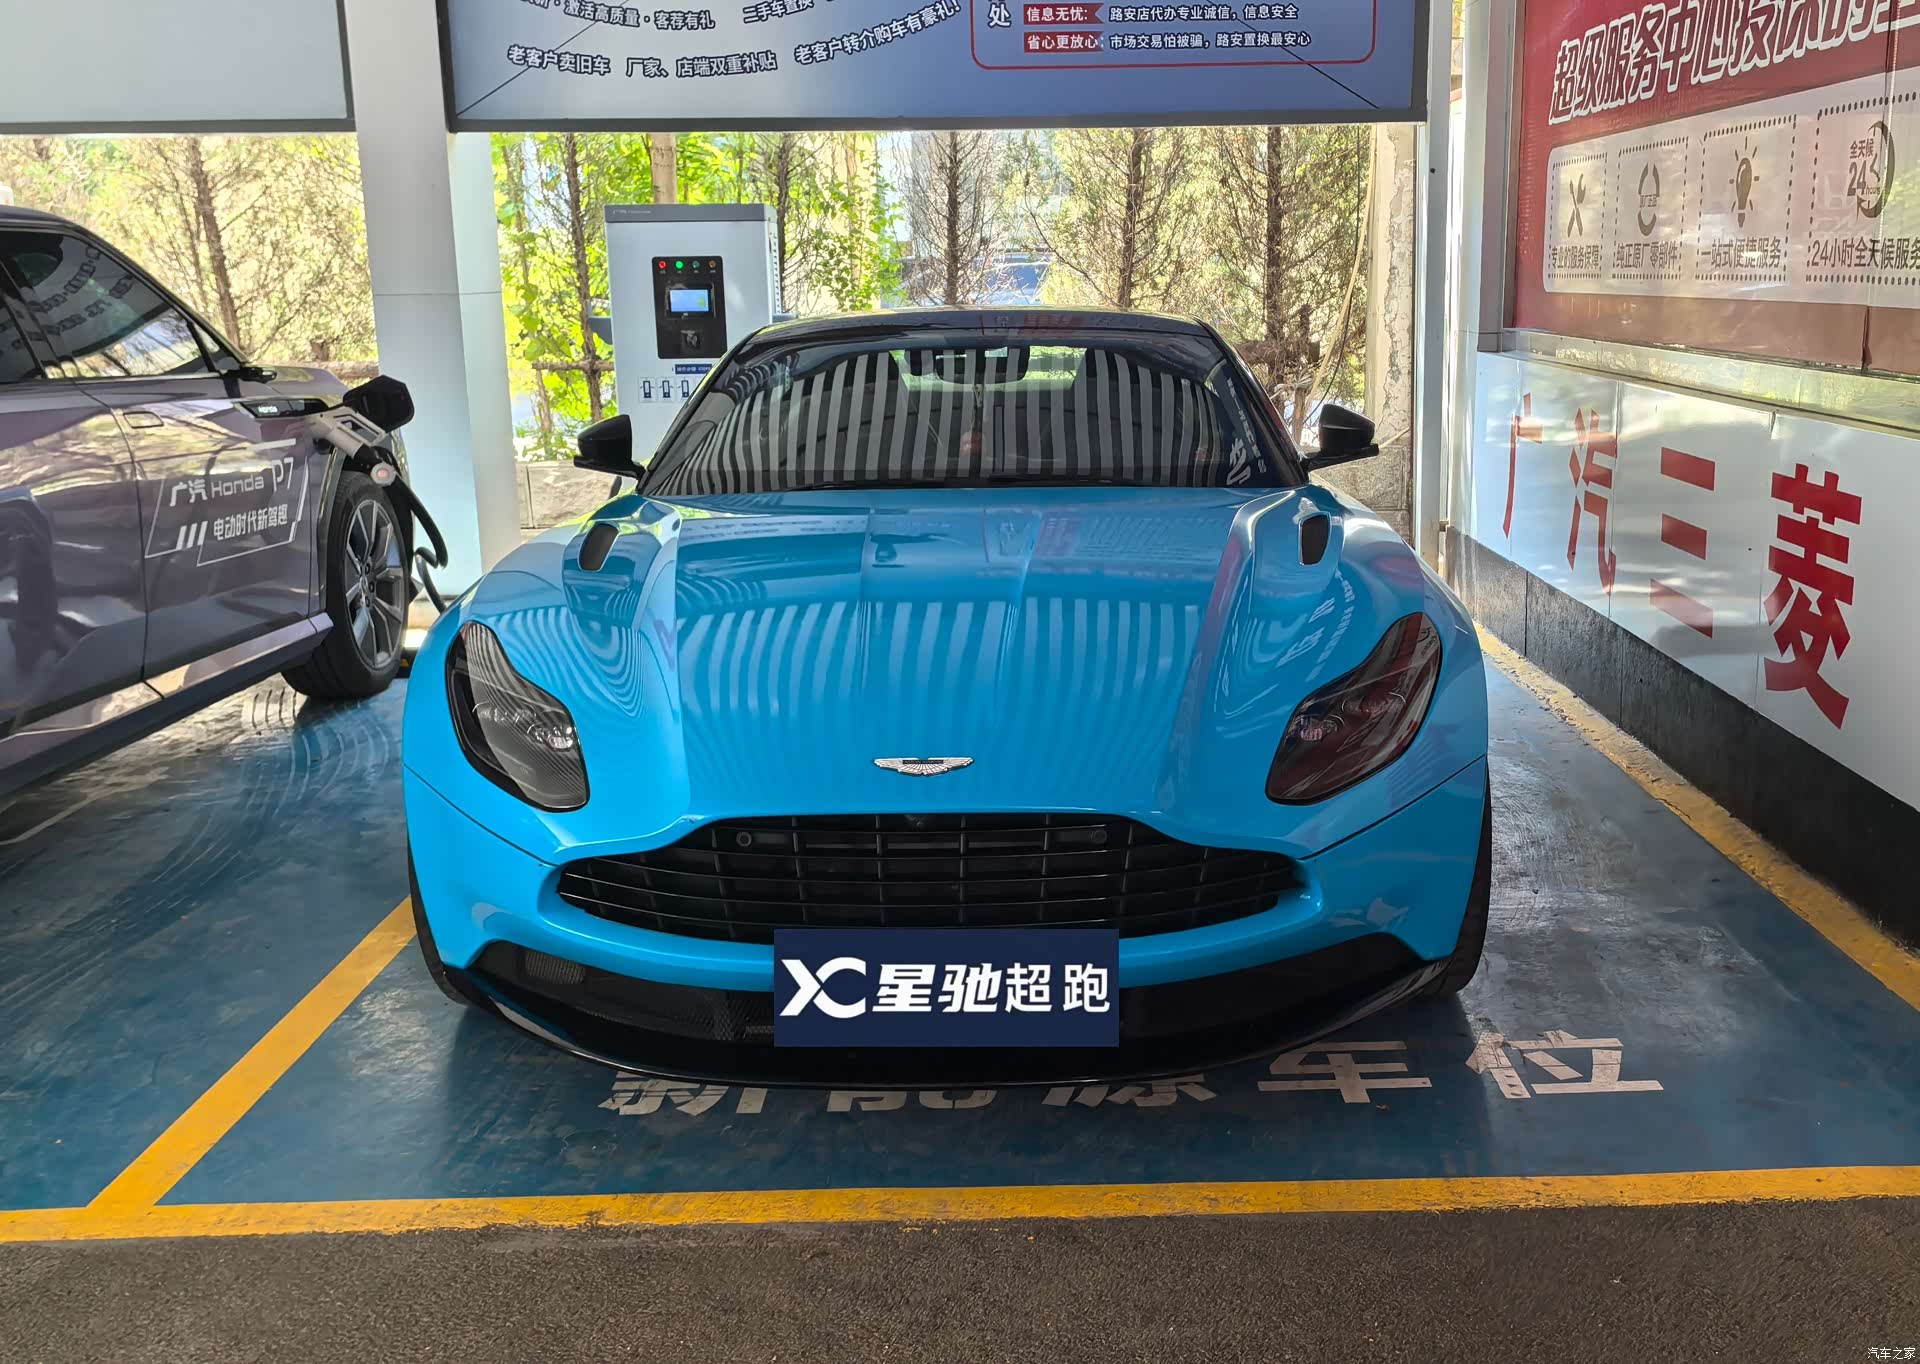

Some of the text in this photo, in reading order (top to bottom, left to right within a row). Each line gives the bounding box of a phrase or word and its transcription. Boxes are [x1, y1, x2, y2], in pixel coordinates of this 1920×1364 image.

[507, 45, 611, 76] 老客户卖旧车
[1849, 137, 1875, 159] 全天候
[1847, 160, 1867, 197] 24
[1551, 244, 1600, 270] 专业的服务保障
[1616, 241, 1678, 269] 纯正原厂零部件
[1701, 236, 1782, 270] 一站式便捷服务
[1811, 236, 1920, 271] 24小时全天候服务
[169, 457, 294, 508] 广汽 Honda P7
